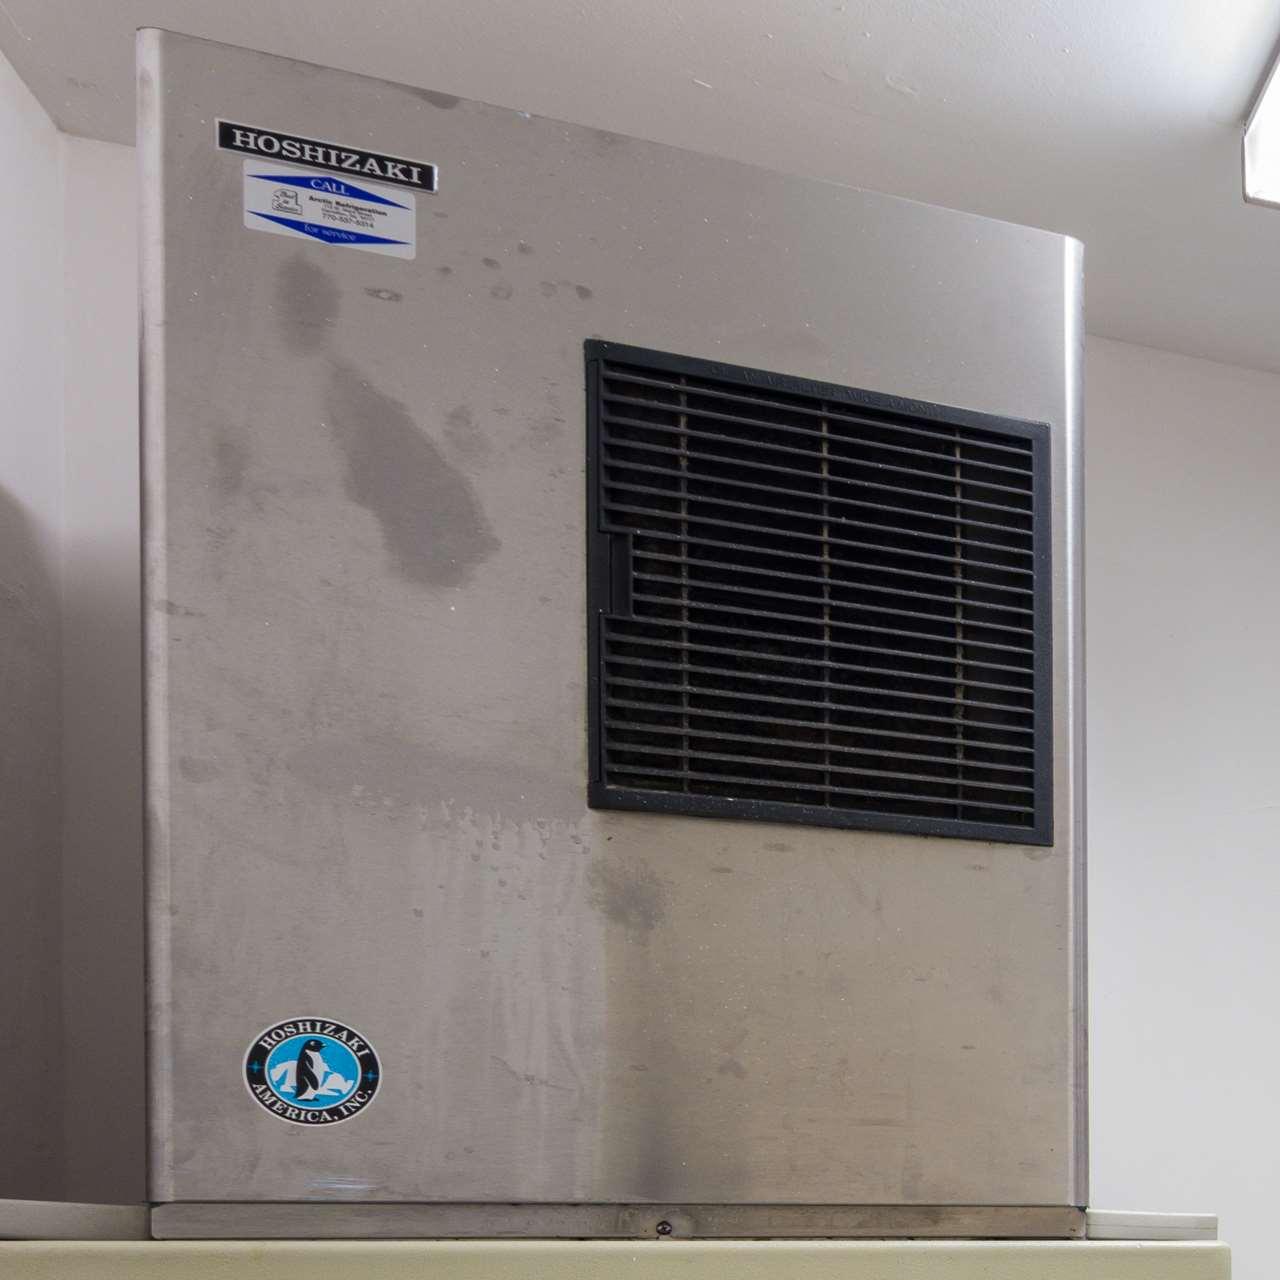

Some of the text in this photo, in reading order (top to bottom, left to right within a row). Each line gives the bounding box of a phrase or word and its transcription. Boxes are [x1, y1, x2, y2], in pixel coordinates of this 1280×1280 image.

[231, 128, 422, 184] HOSHIZAKI
[310, 179, 350, 195] CALL
[258, 1021, 371, 1057] HOSHIZAKI
[253, 1083, 372, 1122] AMERICA, INC.
